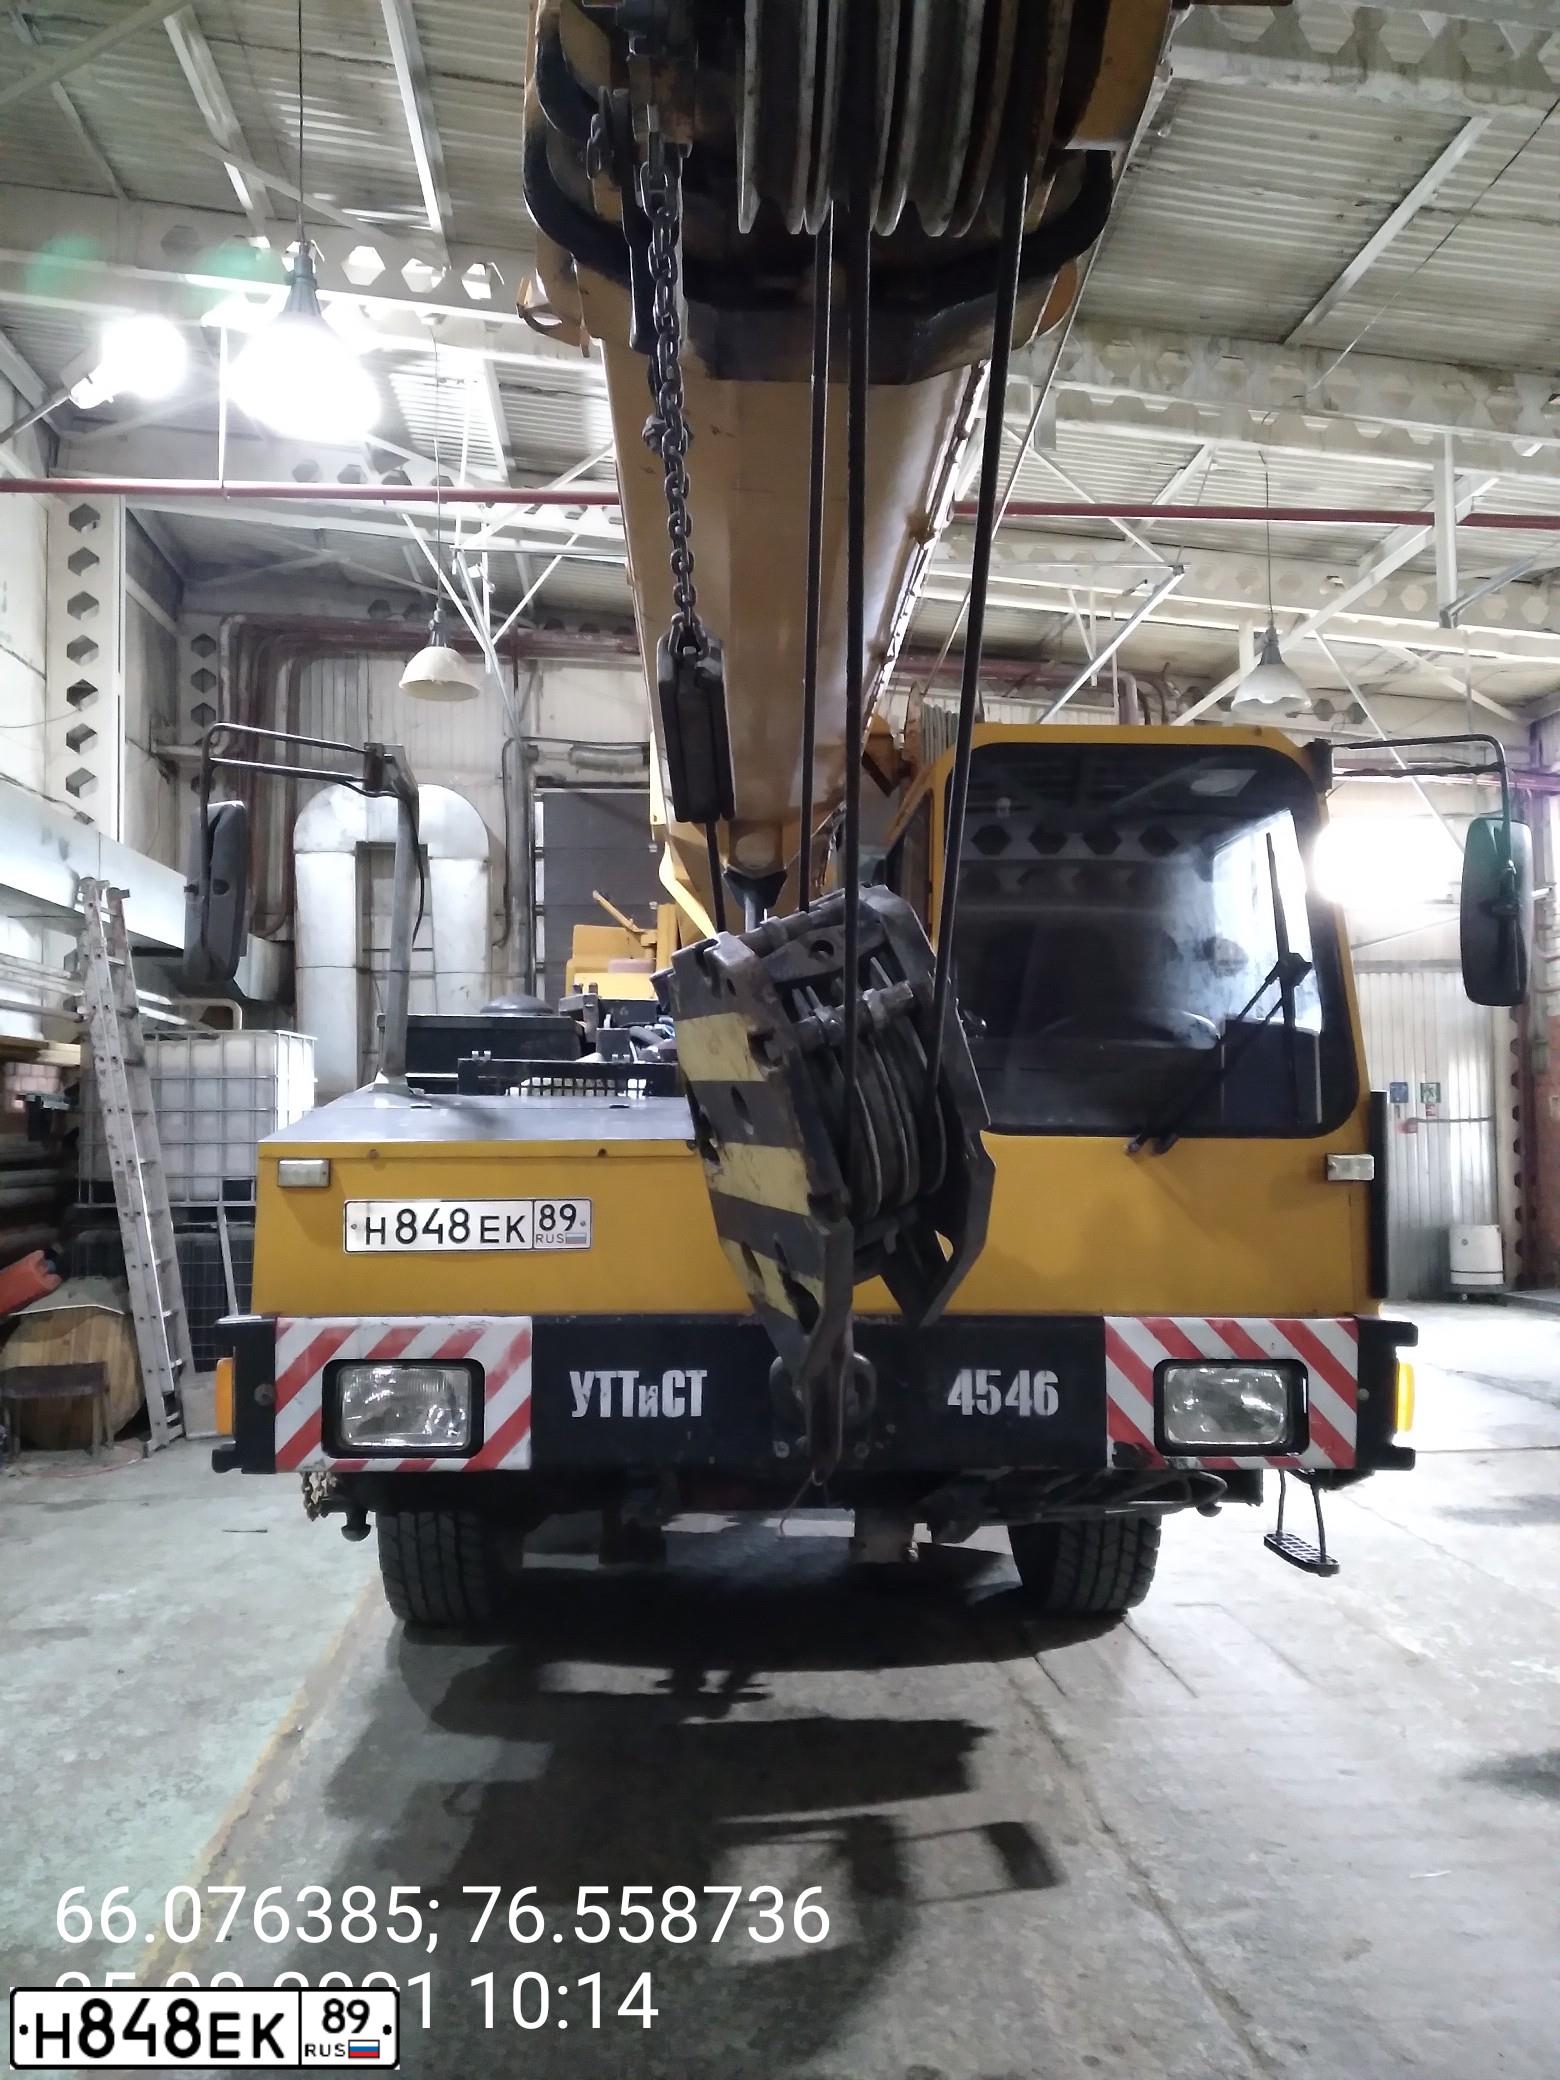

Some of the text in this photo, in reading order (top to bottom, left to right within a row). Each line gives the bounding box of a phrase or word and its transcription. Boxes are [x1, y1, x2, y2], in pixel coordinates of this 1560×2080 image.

[538, 1203, 577, 1231] 89
[535, 1233, 565, 1244] RUS
[947, 1368, 1059, 1417] 4546
